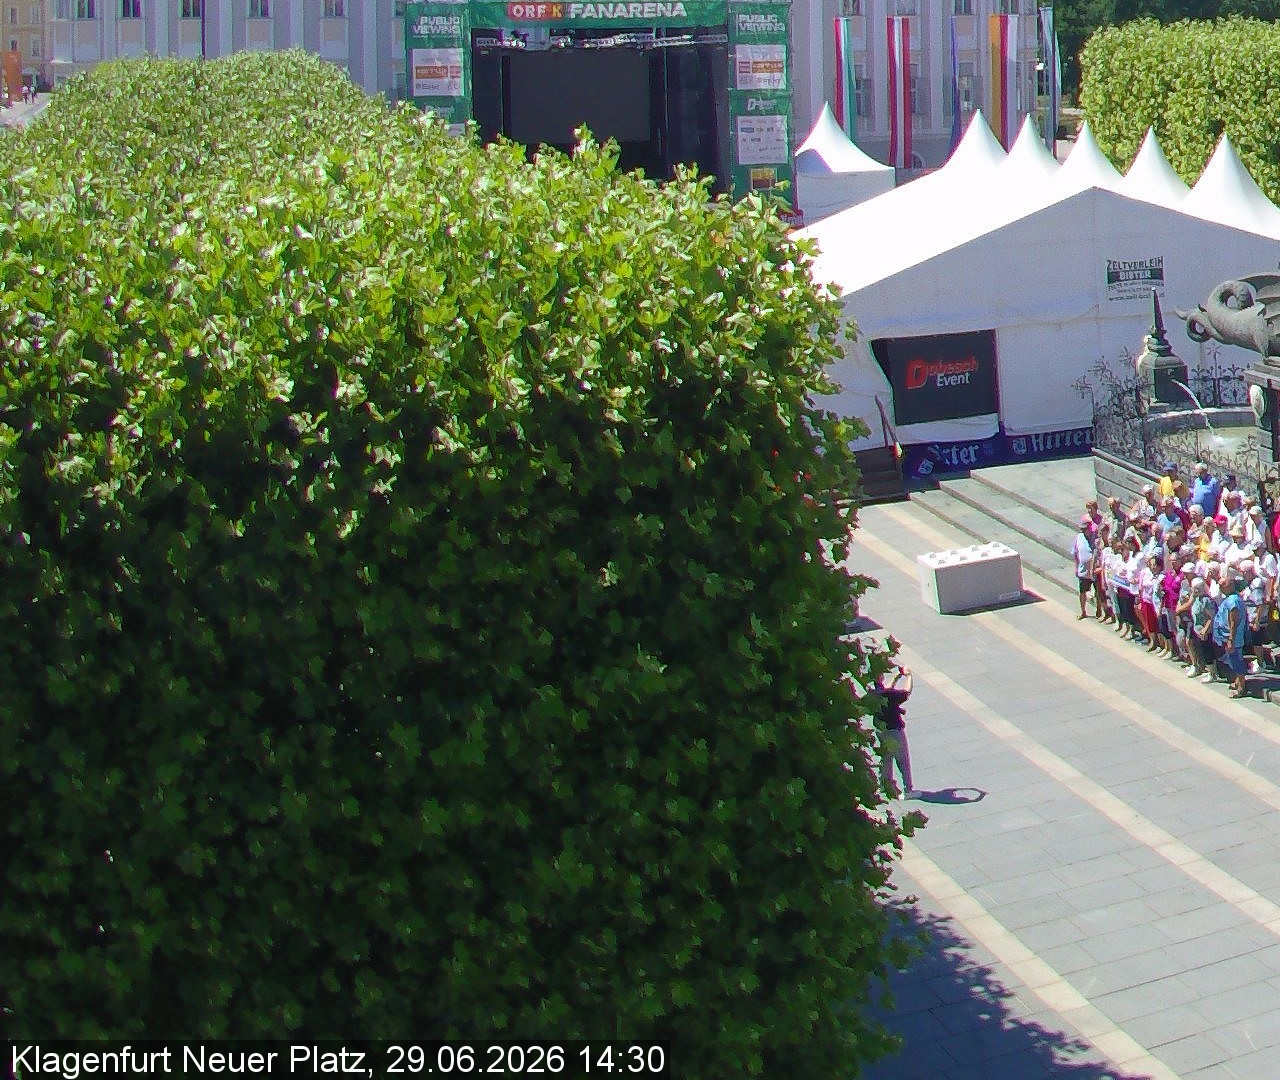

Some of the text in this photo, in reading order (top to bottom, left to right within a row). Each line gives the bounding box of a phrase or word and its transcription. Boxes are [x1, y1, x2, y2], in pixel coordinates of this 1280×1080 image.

[512, 4, 546, 17] ORF
[569, 2, 688, 19] FANARENA
[420, 16, 461, 25] PUBLIC
[738, 14, 778, 23] PUBLIC
[413, 25, 461, 35] VIEWING
[739, 23, 786, 32] VIEWING
[1107, 256, 1163, 271] ZELTVERLEIH
[936, 372, 970, 387] Event
